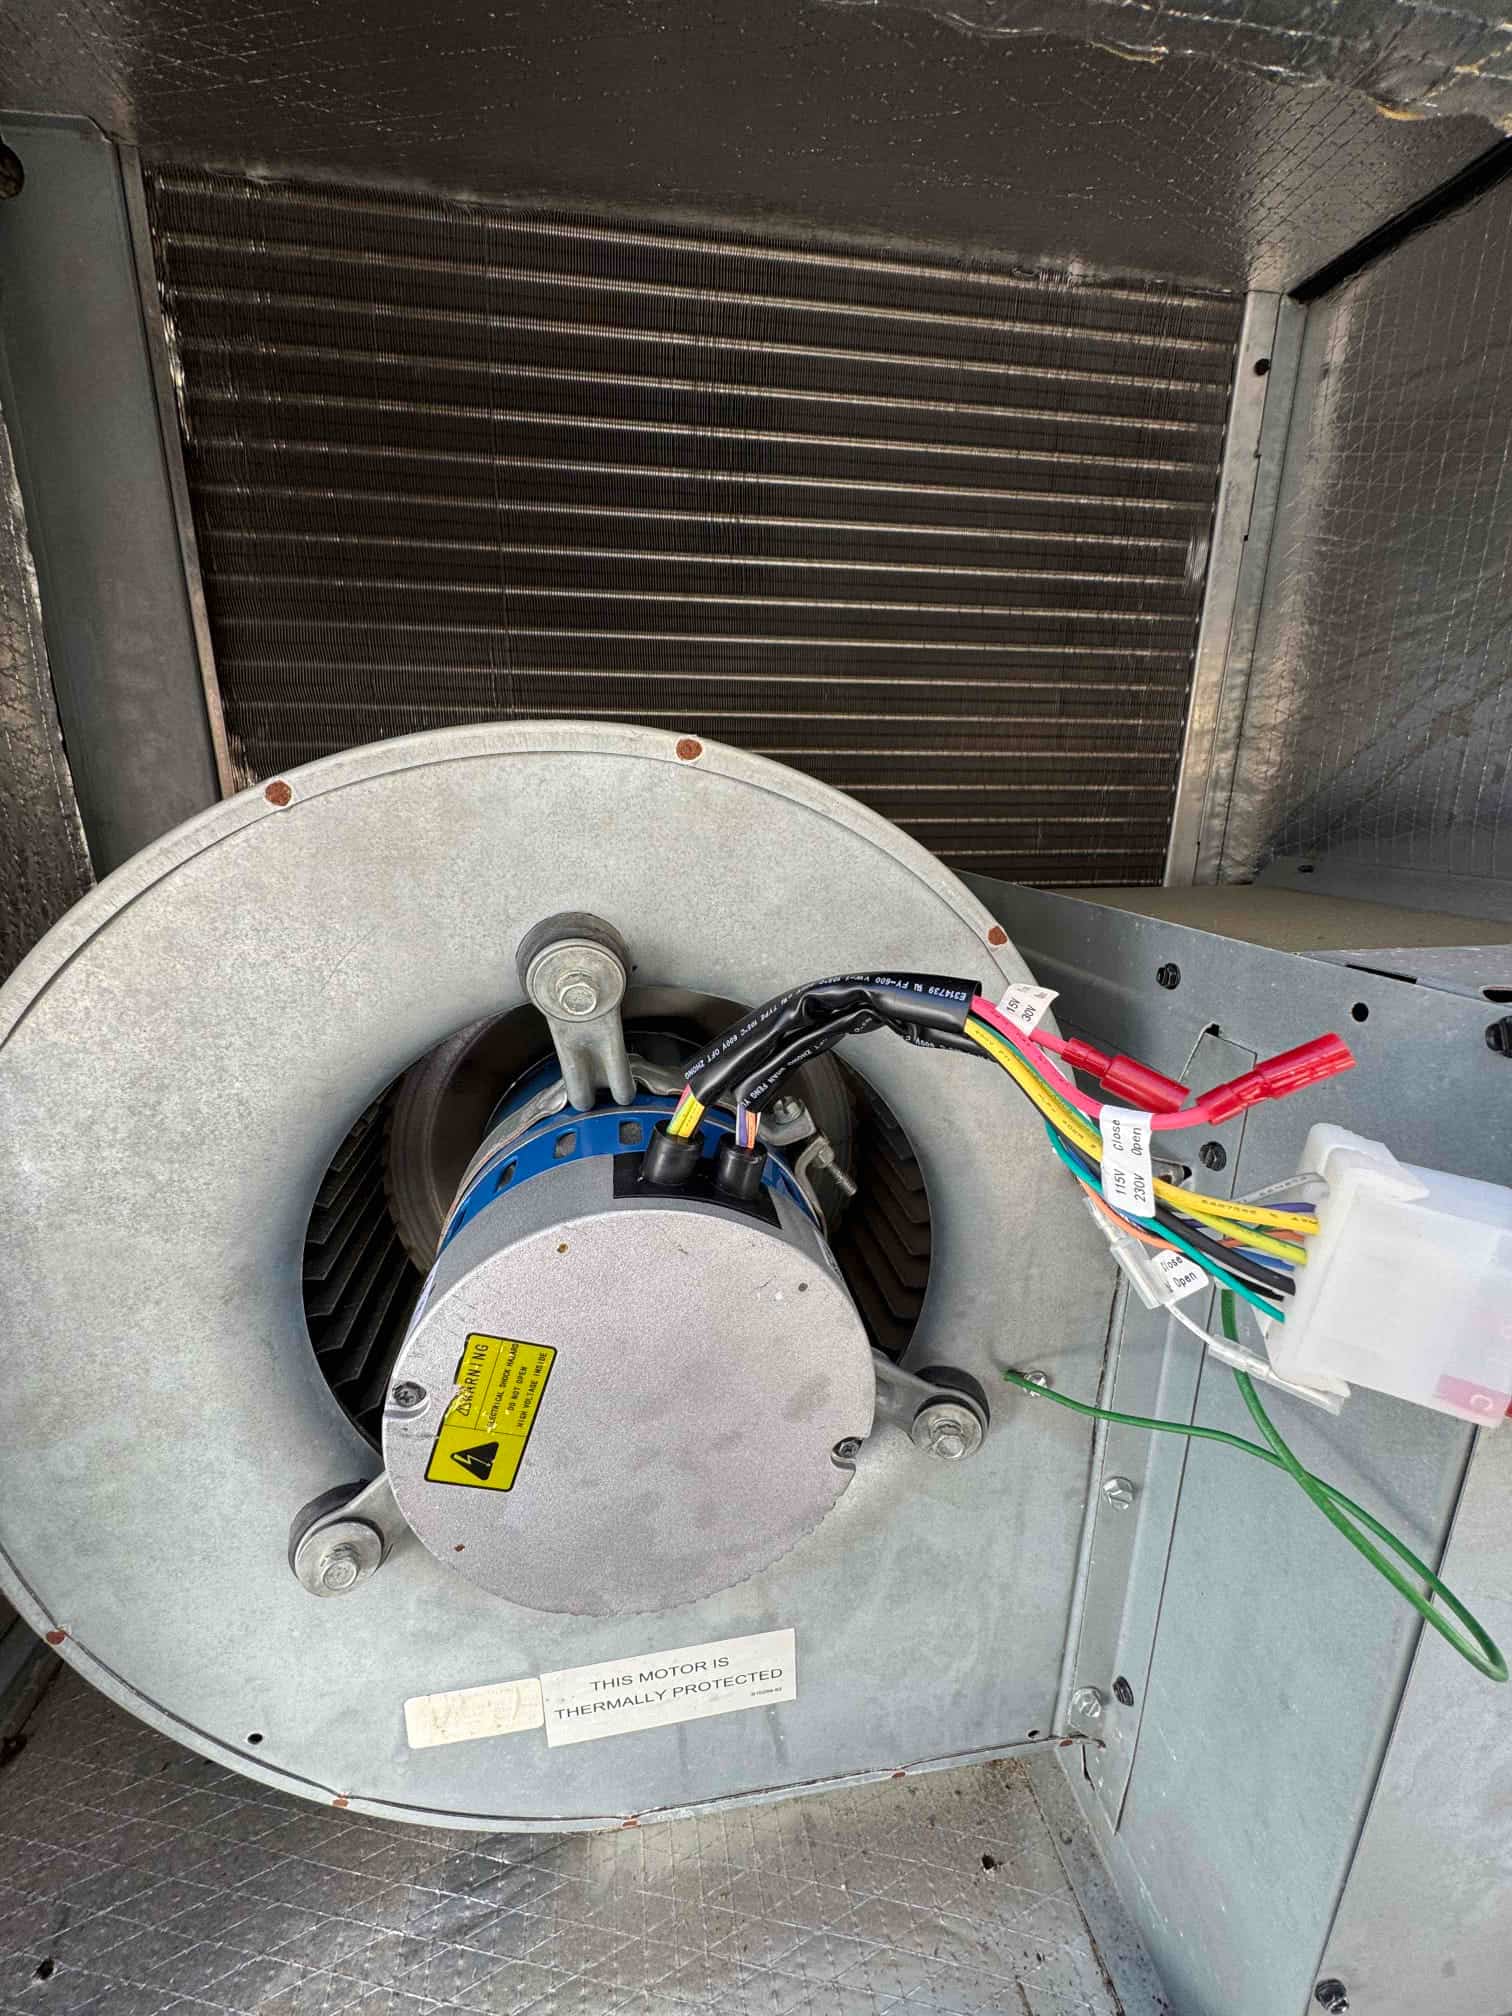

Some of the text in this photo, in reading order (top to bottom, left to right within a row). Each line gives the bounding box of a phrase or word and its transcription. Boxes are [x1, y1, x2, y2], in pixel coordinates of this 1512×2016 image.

[874, 976, 909, 990] FY-600
[927, 986, 967, 1000] E314739
[684, 1059, 705, 1079] ZHONG
[1112, 1118, 1127, 1196] 115V Close
[1130, 1126, 1147, 1204] 230V Open
[1172, 1271, 1198, 1288] Open
[507, 1365, 529, 1412] DO NOT OPEN
[523, 1380, 538, 1409] VOLTAGE
[532, 1351, 548, 1377] INSIDE
[554, 1667, 784, 1720] THERMALLY PROTECTED
[590, 1656, 730, 1693] THIS MOTOR IS
